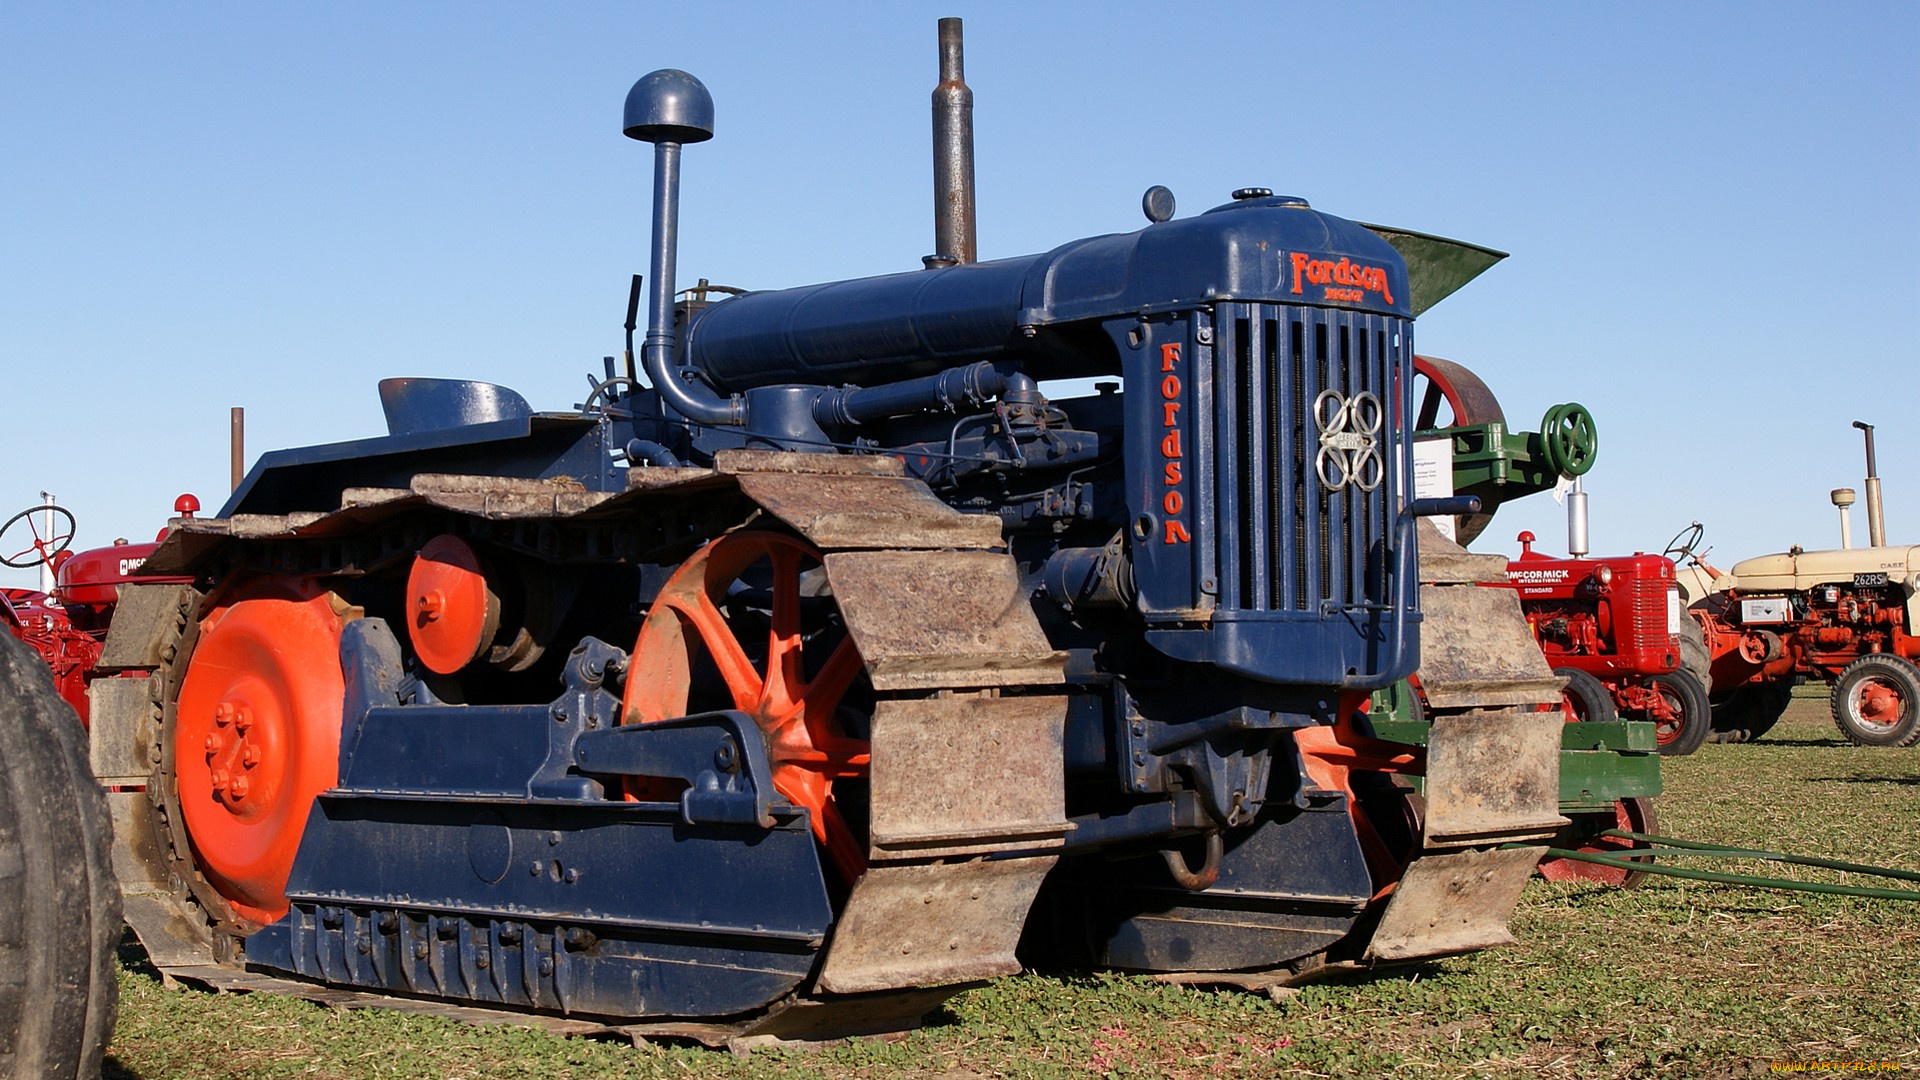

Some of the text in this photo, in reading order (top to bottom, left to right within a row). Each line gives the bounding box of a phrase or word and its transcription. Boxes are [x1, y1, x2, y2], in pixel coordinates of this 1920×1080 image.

[1290, 252, 1393, 305] Fordson
[1160, 342, 1191, 544] Fordson
[1509, 569, 1569, 579] McCORMICK
[1855, 574, 1882, 586] 262RS
